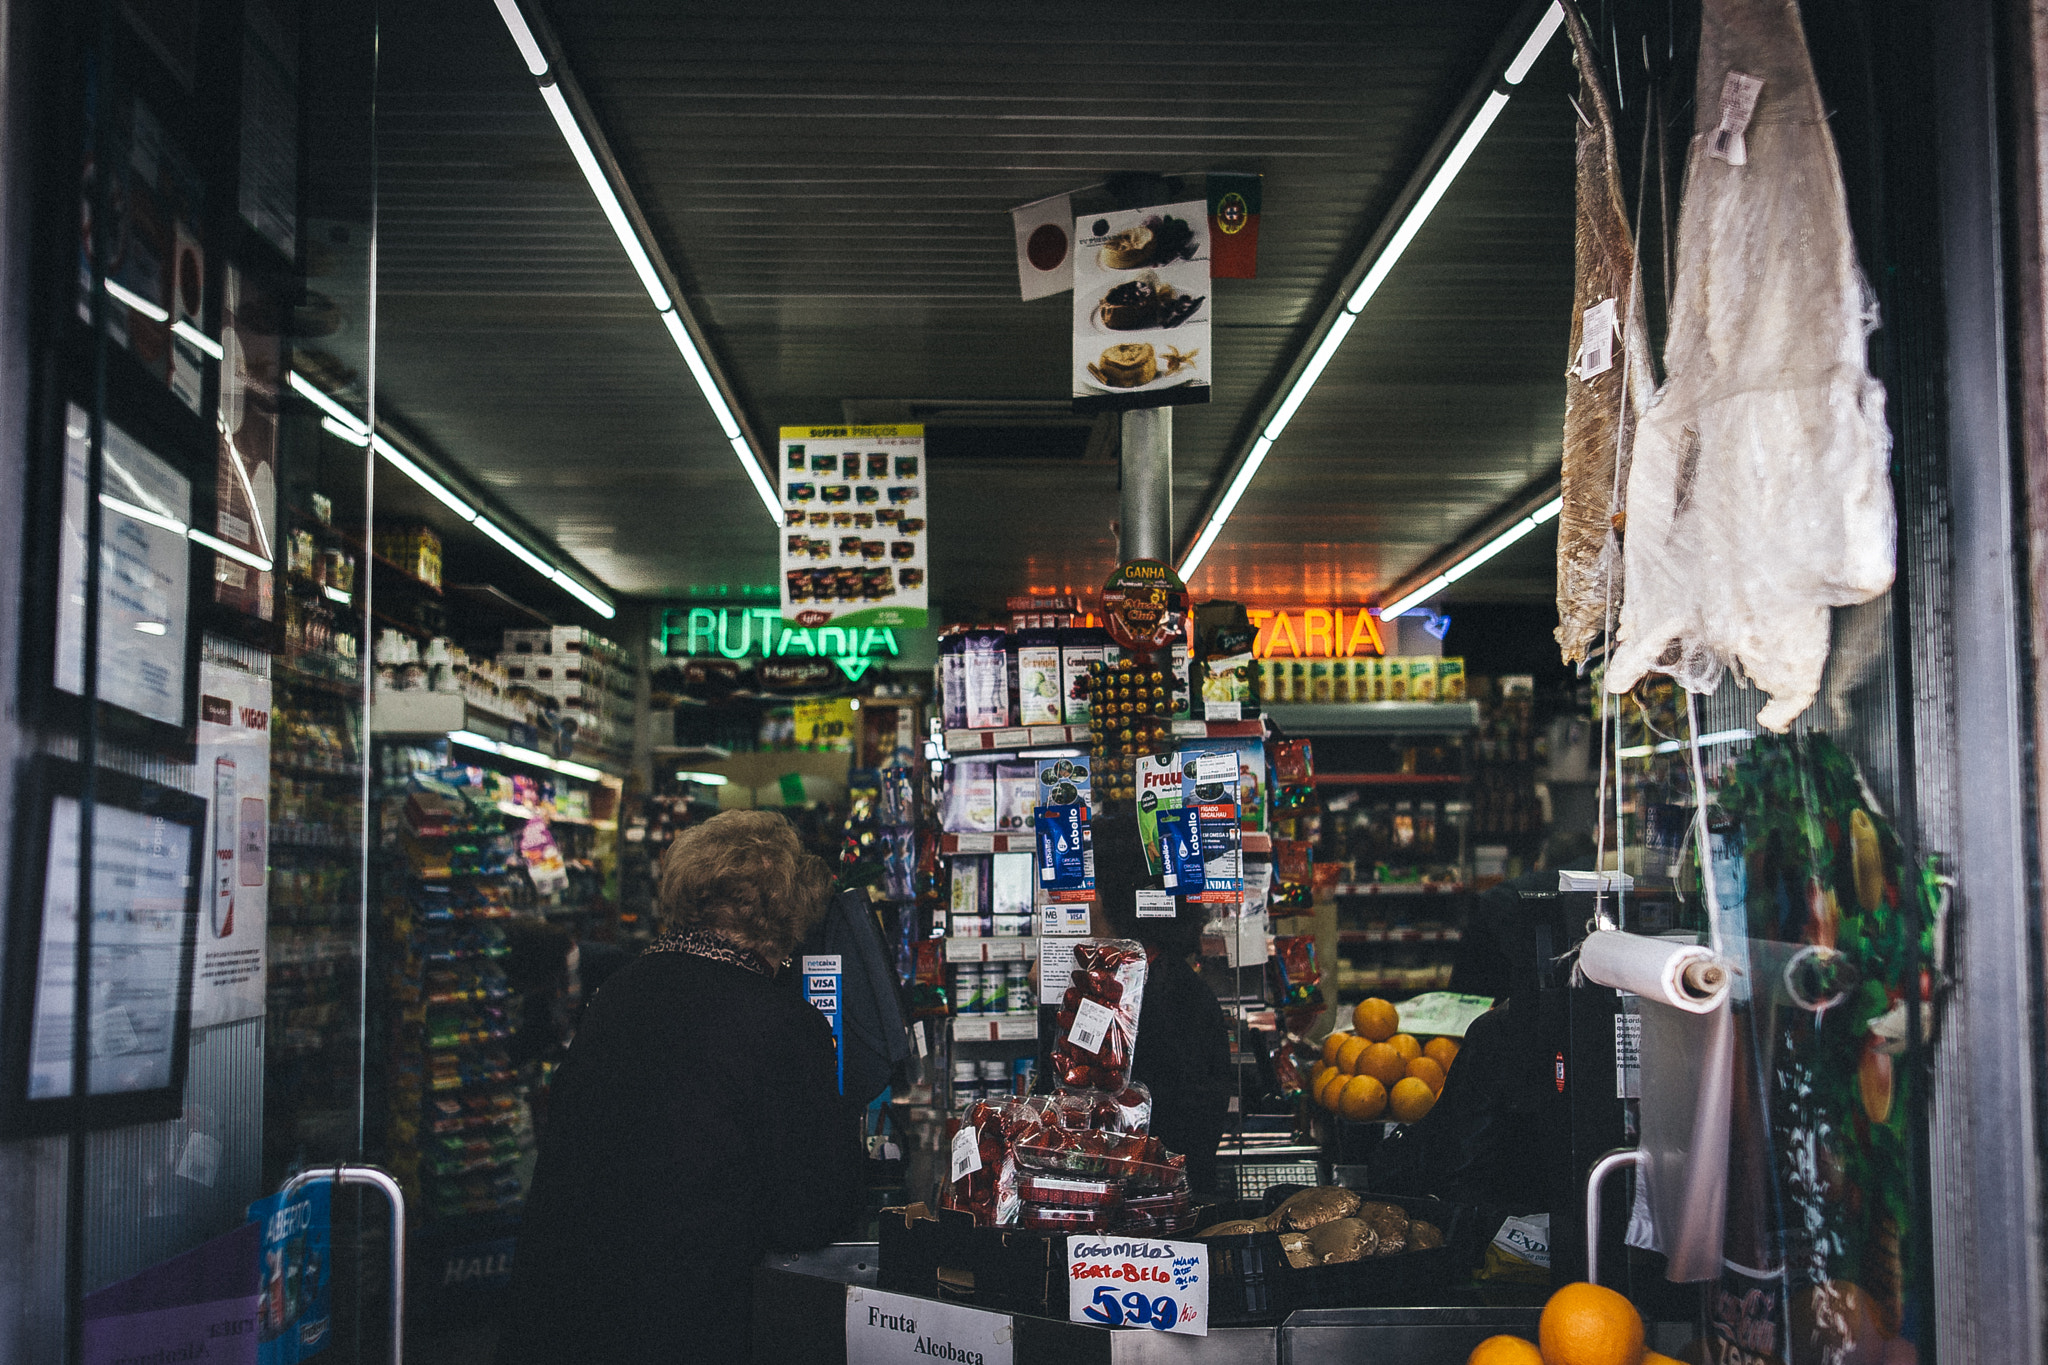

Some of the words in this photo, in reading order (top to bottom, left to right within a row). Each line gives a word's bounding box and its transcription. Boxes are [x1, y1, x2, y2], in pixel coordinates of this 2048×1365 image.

[809, 429, 848, 437] SUPER
[1125, 566, 1166, 579] GANHA
[1143, 771, 1183, 788] Fruu
[1069, 808, 1080, 850] Labello
[1188, 812, 1200, 856] Labello
[1045, 911, 1058, 919] MB
[812, 979, 835, 988] VISA
[812, 998, 835, 1008] VISA
[867, 1305, 916, 1334] Fruta
[913, 1335, 985, 1365] Alcobaça
